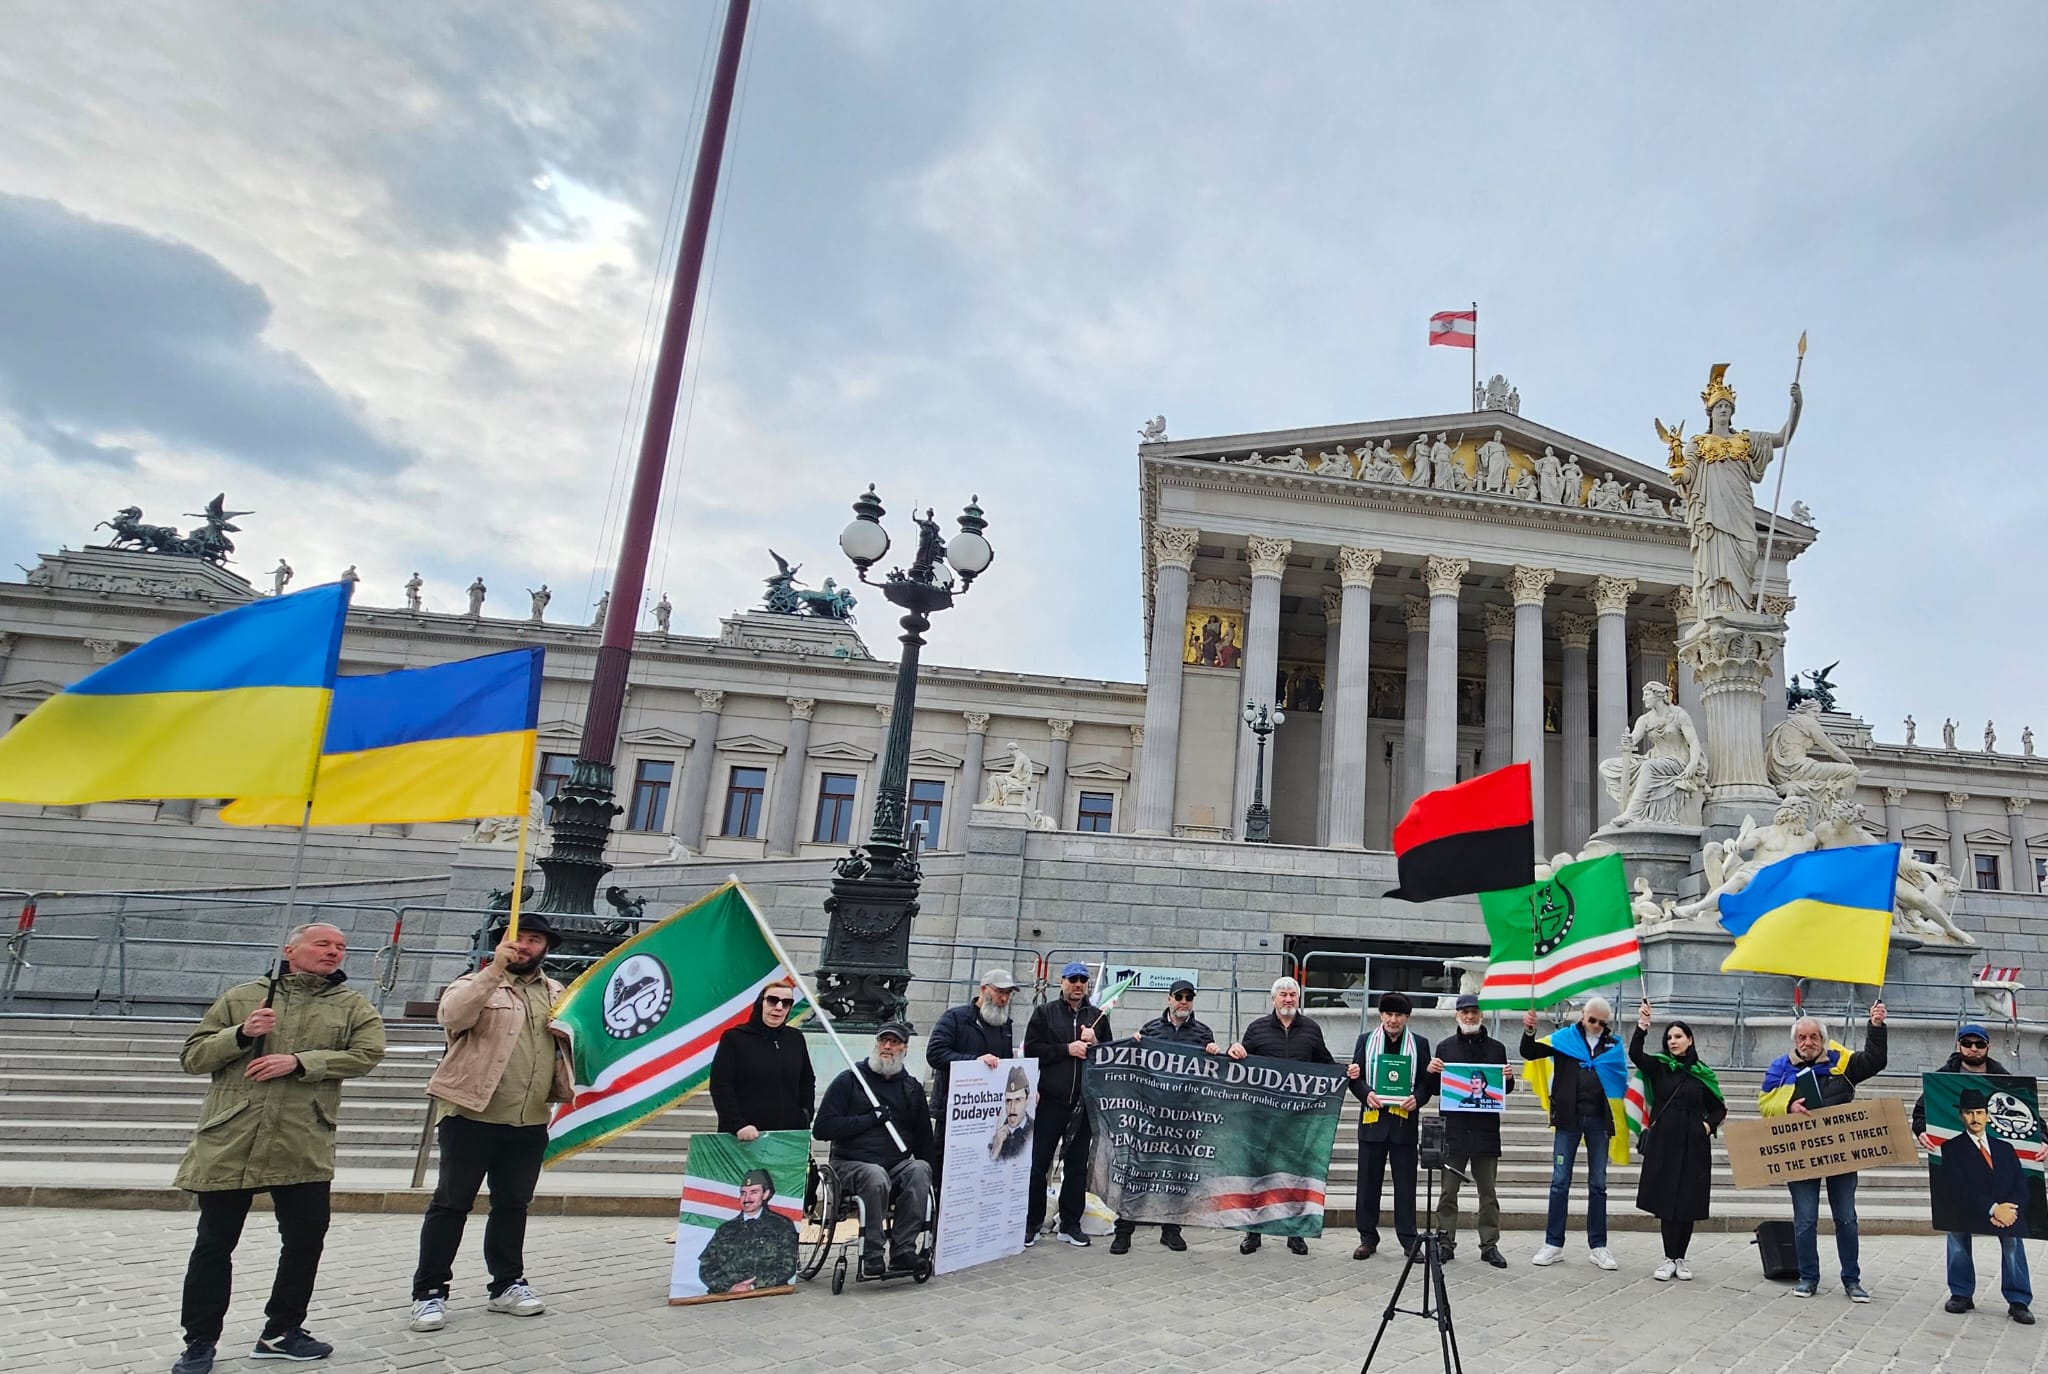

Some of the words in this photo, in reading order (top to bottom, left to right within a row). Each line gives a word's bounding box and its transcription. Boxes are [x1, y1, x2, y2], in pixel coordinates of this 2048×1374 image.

[1095, 1046, 1219, 1079] DZHOHAR
[1225, 1062, 1347, 1095] DUDAYEV
[954, 1090, 1003, 1106] Dzhokhar
[1105, 1072, 1127, 1081] First
[1129, 1073, 1170, 1091] President
[1172, 1084, 1182, 1092] of
[1184, 1084, 1199, 1094] the
[1201, 1086, 1240, 1100] Chechen
[1242, 1092, 1279, 1108] Republic
[1280, 1100, 1292, 1111] of
[952, 1106, 1002, 1120] Dudayev
[1099, 1097, 1156, 1118] DZHOHAR
[1160, 1107, 1224, 1125] DUDAYEV:
[1772, 1119, 1817, 1136] DUDAYEV
[1822, 1110, 1868, 1127] WARNED:
[1118, 1114, 1136, 1128] 30
[1138, 1117, 1183, 1140] YEARS
[1186, 1129, 1203, 1140] OF
[1760, 1141, 1796, 1156] RUSSIA
[1801, 1136, 1834, 1150] POSES
[1839, 1134, 1846, 1143] A
[1850, 1126, 1889, 1142] THREAT
[1767, 1164, 1781, 1174] TO
[1785, 1160, 1806, 1172] THE
[1810, 1152, 1847, 1168] ENTIRE
[1850, 1146, 1892, 1160] WORLD.
[1178, 1172, 1200, 1182] 1944
